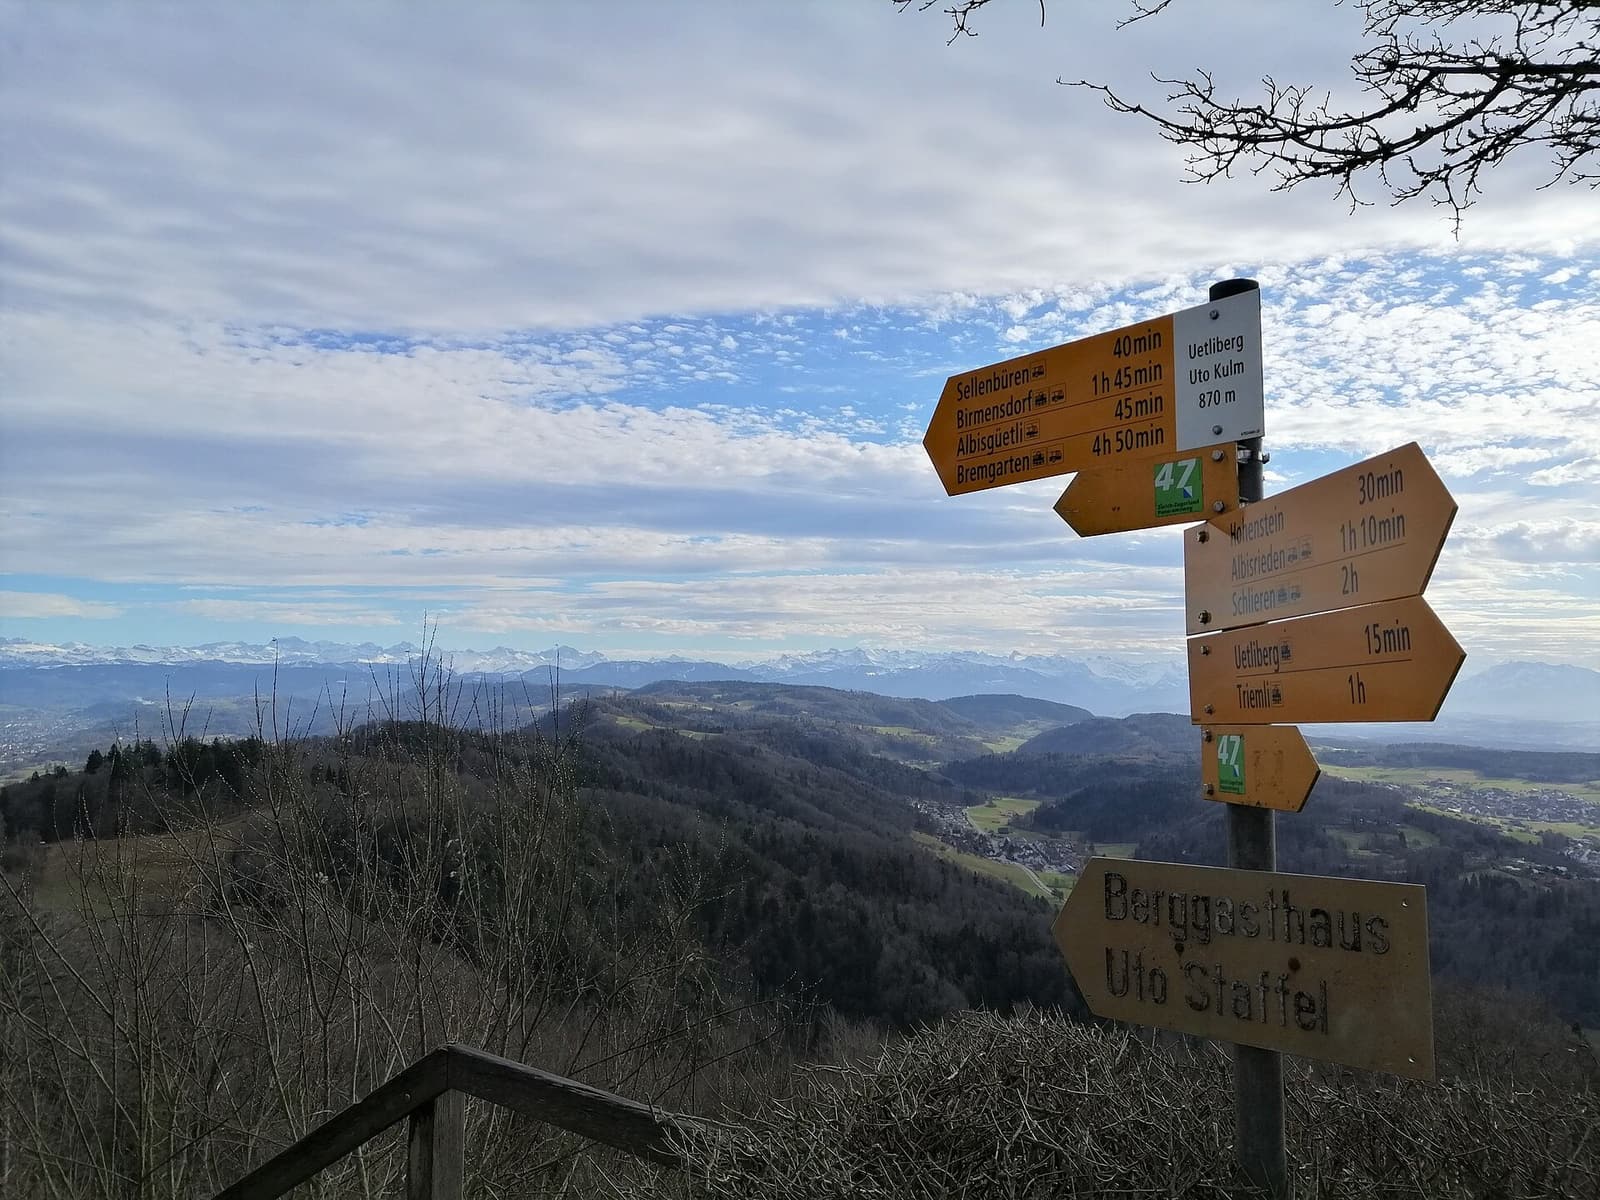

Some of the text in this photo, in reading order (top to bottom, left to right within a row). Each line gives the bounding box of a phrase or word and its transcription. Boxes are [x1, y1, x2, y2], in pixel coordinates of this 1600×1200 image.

[1188, 335, 1244, 360] Uetliberg
[957, 368, 1029, 402] Sellenbüren
[1189, 360, 1245, 385] Uto Kulm
[957, 389, 1033, 430] Birmensdorf
[1199, 389, 1236, 409] 870 m
[957, 422, 1023, 457] Albisgüetli
[957, 455, 1030, 484] Bremgarten
[1154, 458, 1197, 491] 47
[1230, 506, 1285, 547] Hohenstein
[1231, 544, 1286, 582] Albisrieden
[1232, 585, 1276, 617] Schlieren
[1234, 640, 1280, 672] Uetliberg
[1236, 680, 1271, 709] Triemli
[1217, 735, 1241, 765] 47
[1104, 871, 1391, 956] Berggasthaus
[1105, 946, 1329, 1035] Uto Staffel
